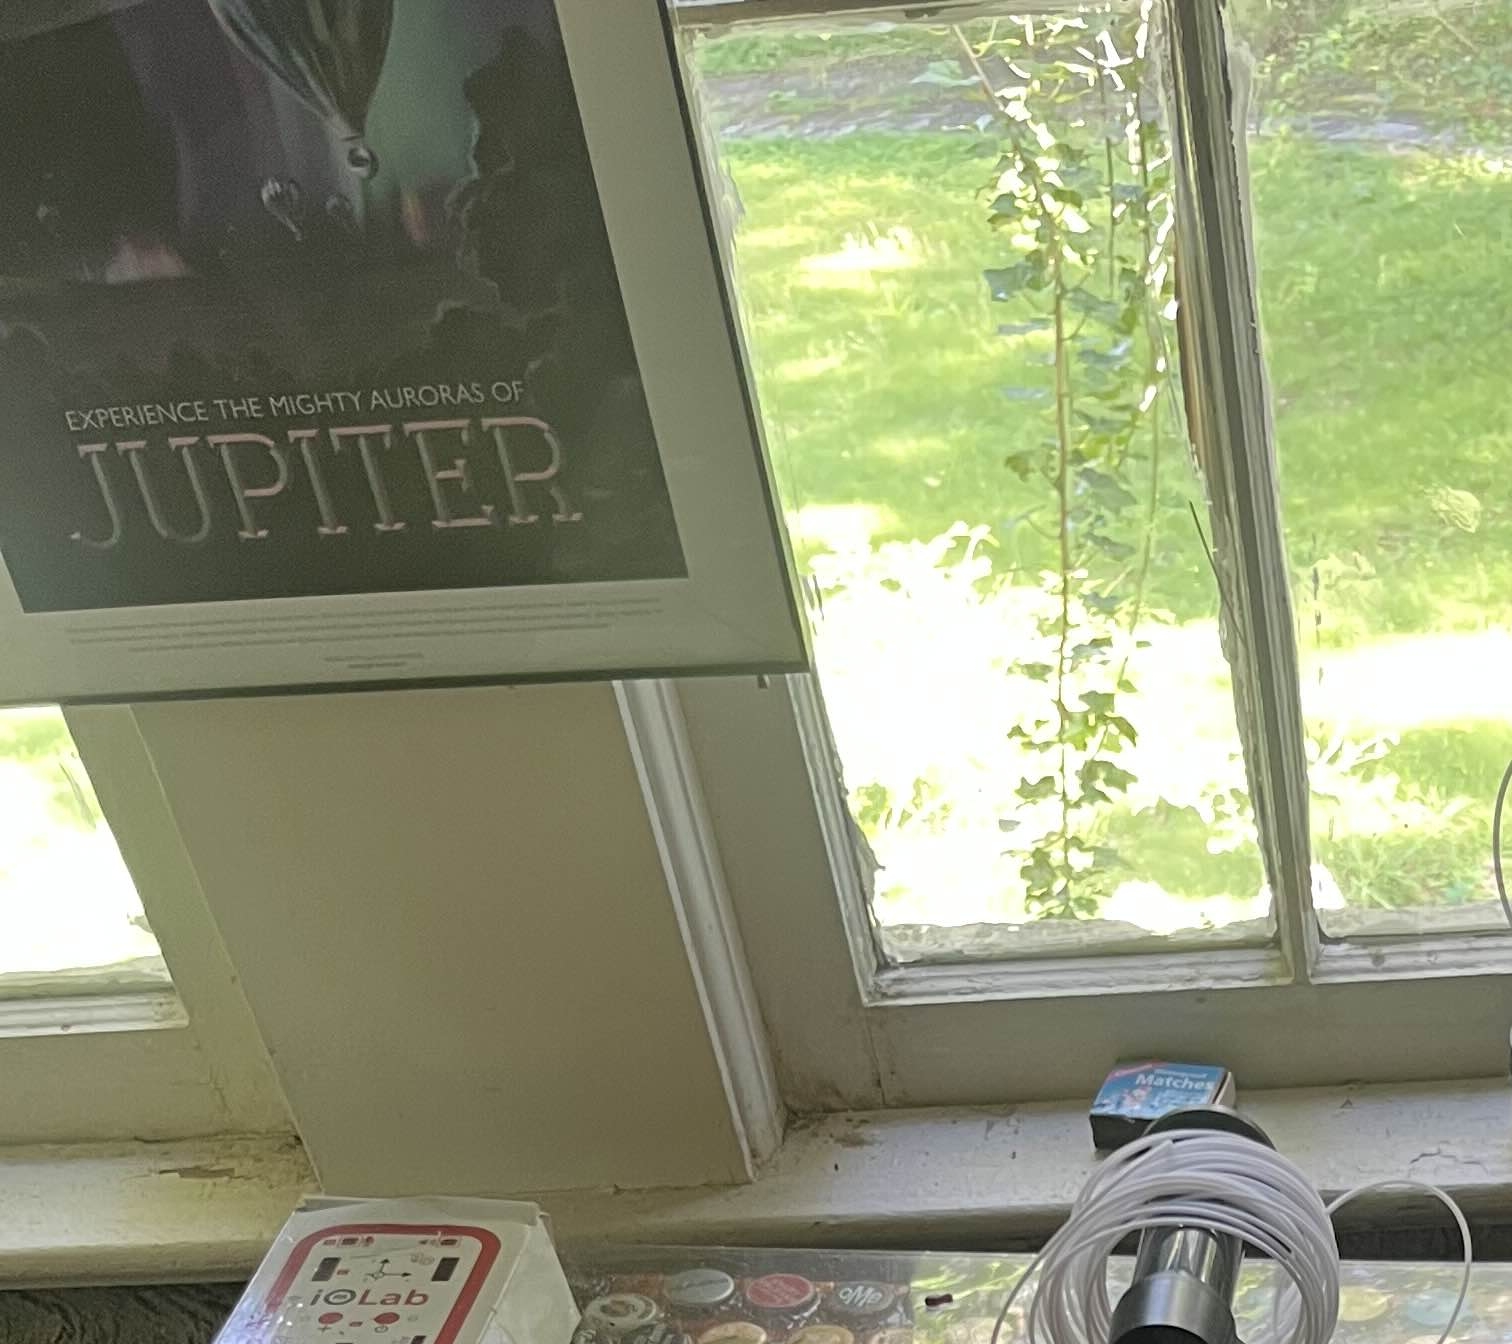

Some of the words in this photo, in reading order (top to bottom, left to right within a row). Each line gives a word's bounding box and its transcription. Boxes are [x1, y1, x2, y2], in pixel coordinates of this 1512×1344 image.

[64, 401, 209, 432] EXPERIENCE
[213, 397, 265, 421] THE
[270, 389, 361, 417] MIGHTY
[370, 383, 485, 412] AURORAS
[491, 380, 525, 402] OF
[69, 415, 584, 549] JUPITER
[1135, 1074, 1216, 1091] Matches
